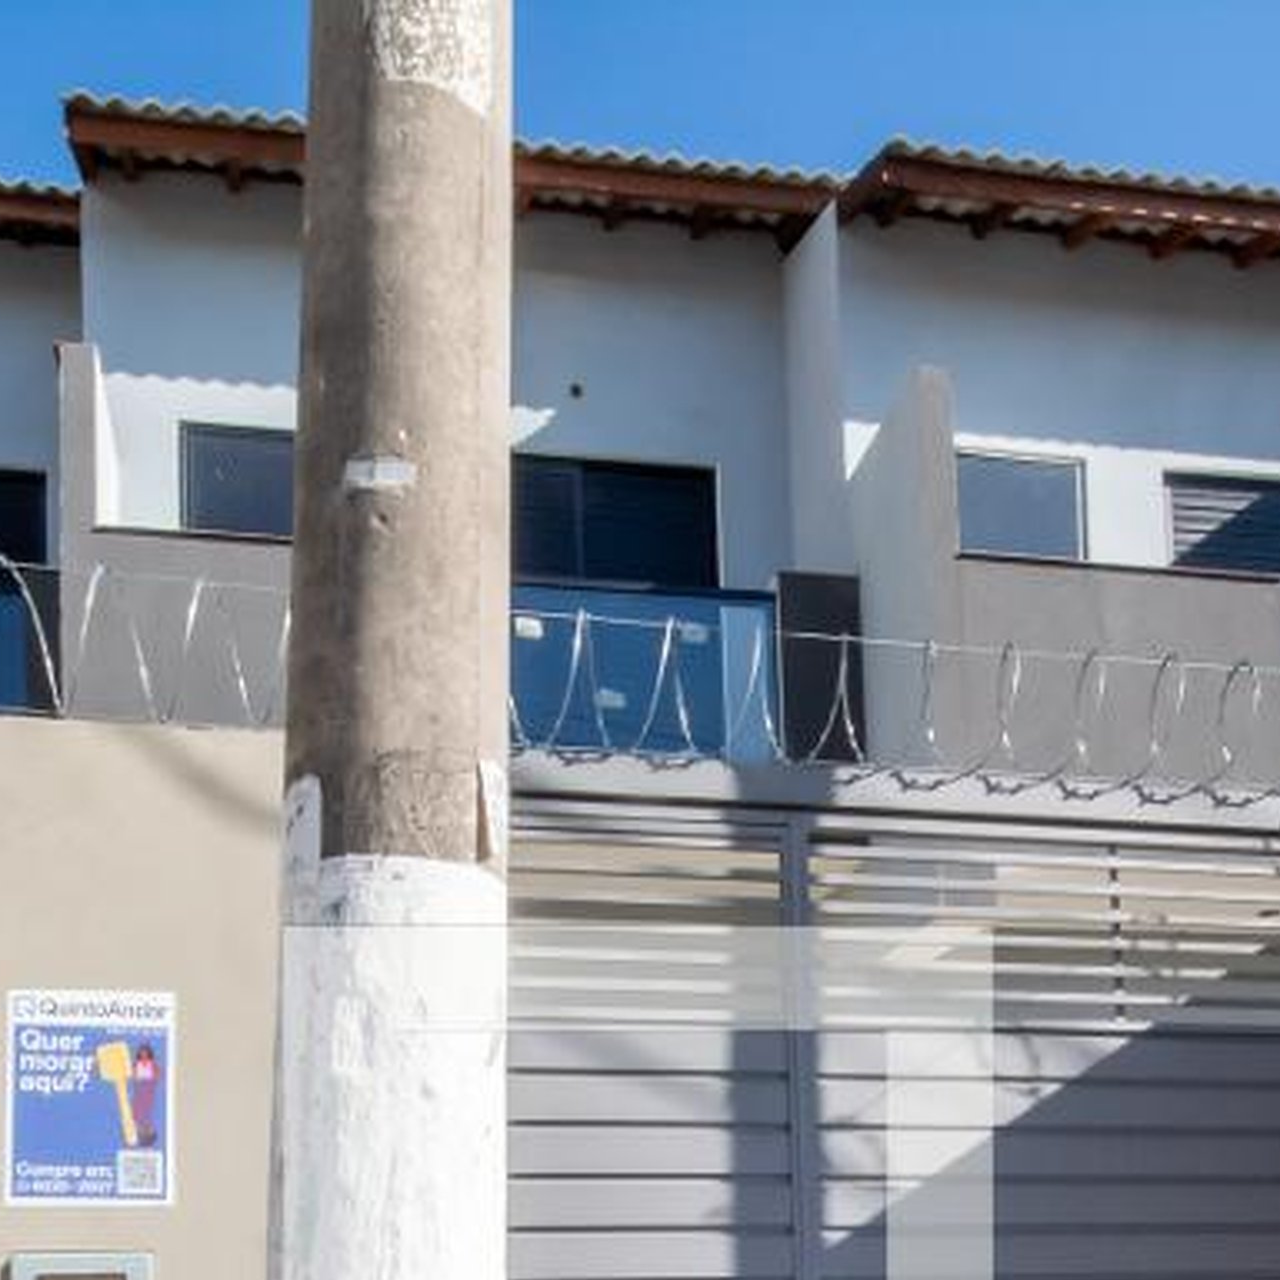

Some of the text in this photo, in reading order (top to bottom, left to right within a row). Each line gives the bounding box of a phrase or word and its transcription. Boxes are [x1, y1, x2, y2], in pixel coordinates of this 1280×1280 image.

[21, 1030, 84, 1051] Quer
[20, 1054, 94, 1072] morar
[20, 1073, 90, 1094] aqui?
